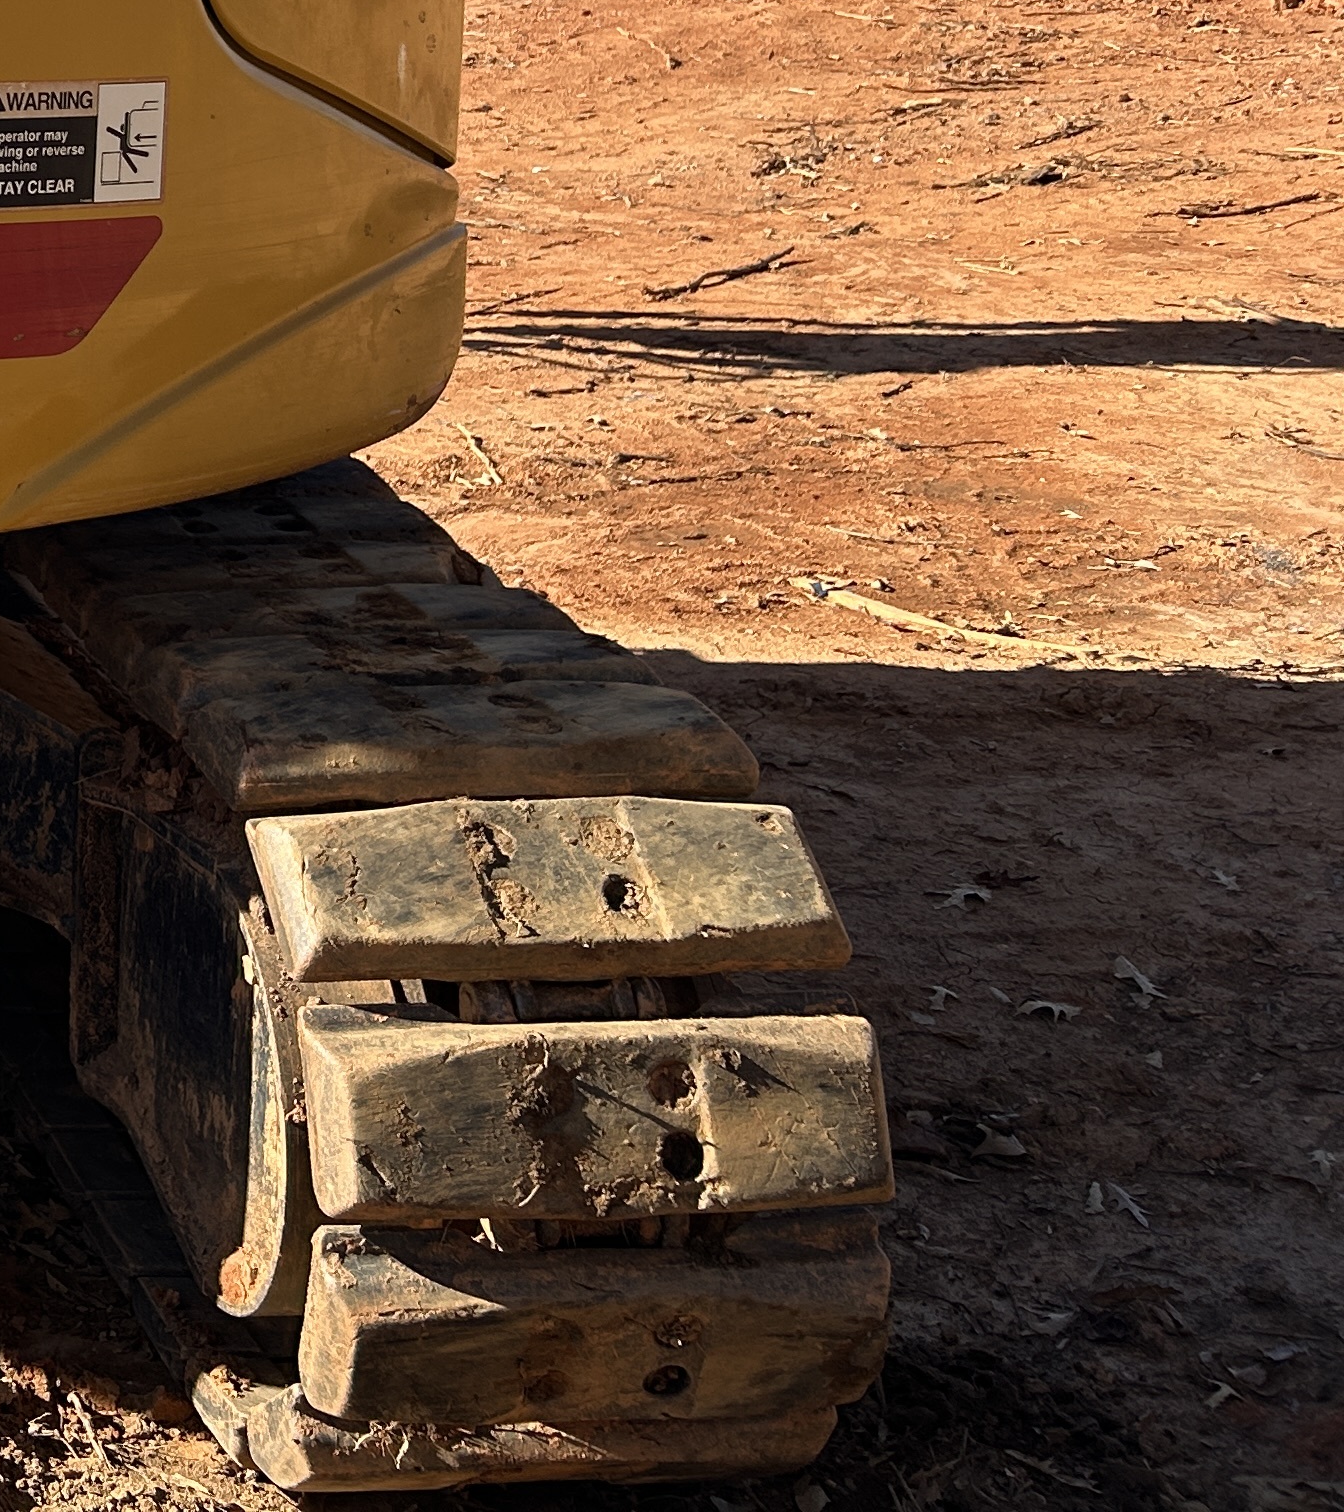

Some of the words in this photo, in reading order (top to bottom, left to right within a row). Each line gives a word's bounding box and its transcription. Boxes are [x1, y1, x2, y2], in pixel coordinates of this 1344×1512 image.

[6, 92, 93, 111] WARNING
[44, 131, 68, 143] may
[26, 147, 39, 157] or
[42, 145, 85, 156] reverse
[28, 179, 74, 194] CLEAR
